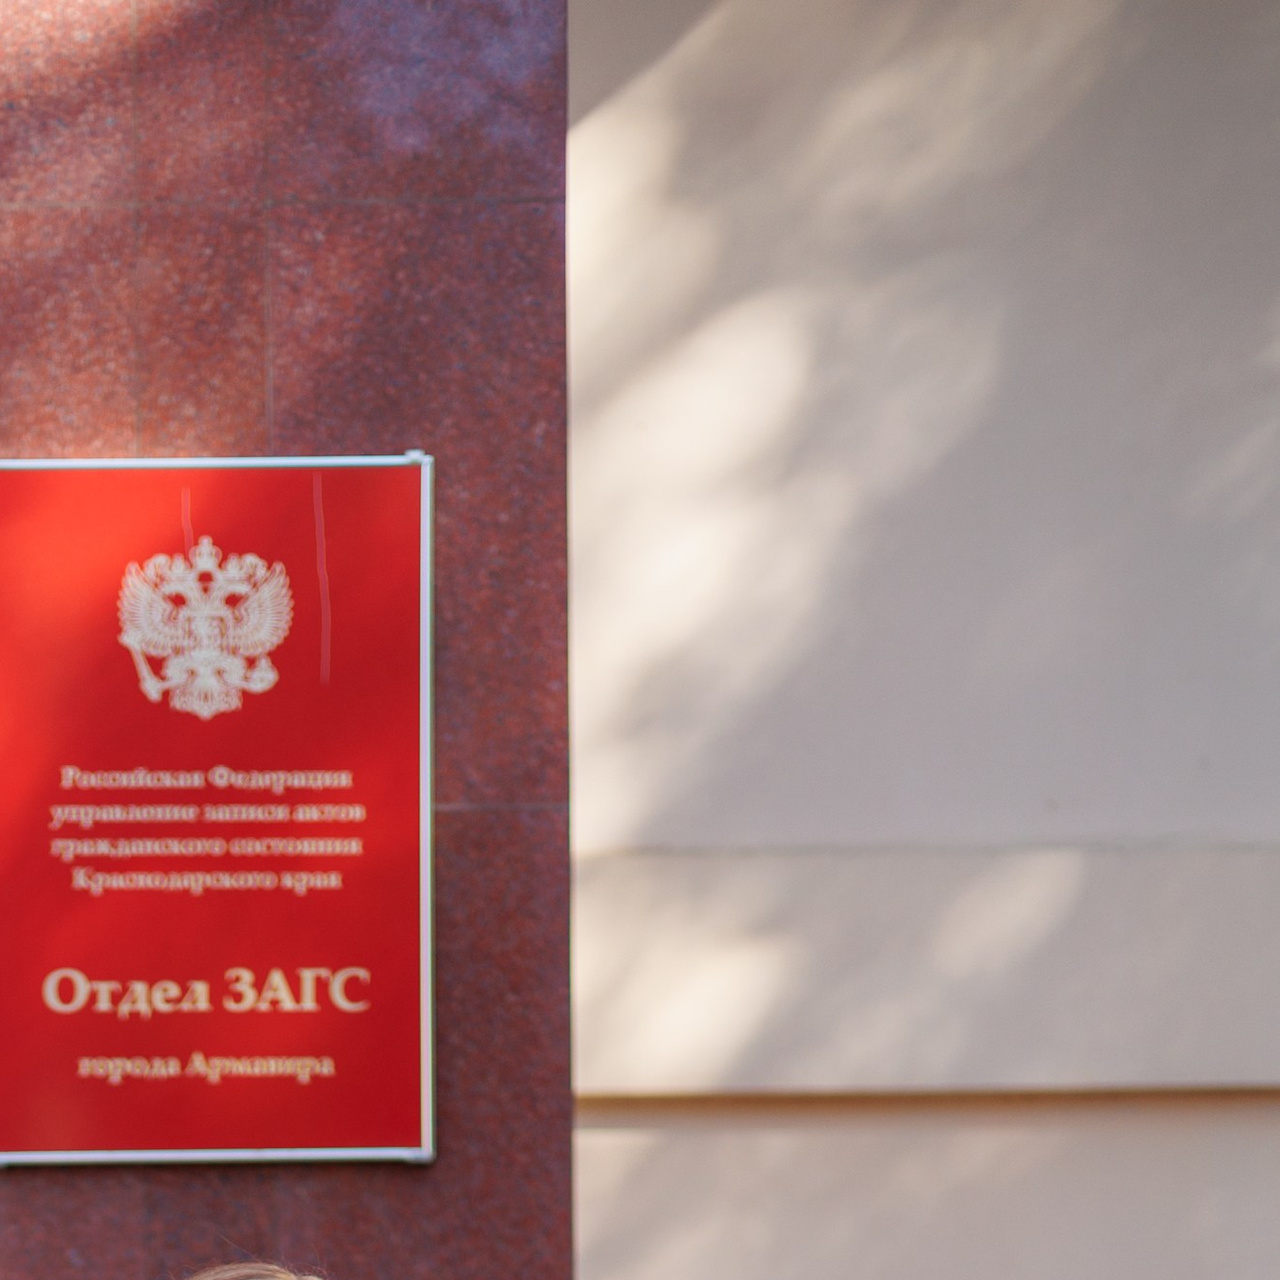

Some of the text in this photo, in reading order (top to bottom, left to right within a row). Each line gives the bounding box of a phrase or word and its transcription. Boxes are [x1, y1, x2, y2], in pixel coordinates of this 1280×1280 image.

[207, 765, 352, 795] Федерация
[42, 966, 371, 1020] Отдел ЗАГС
[77, 1051, 335, 1084] города Армавира
